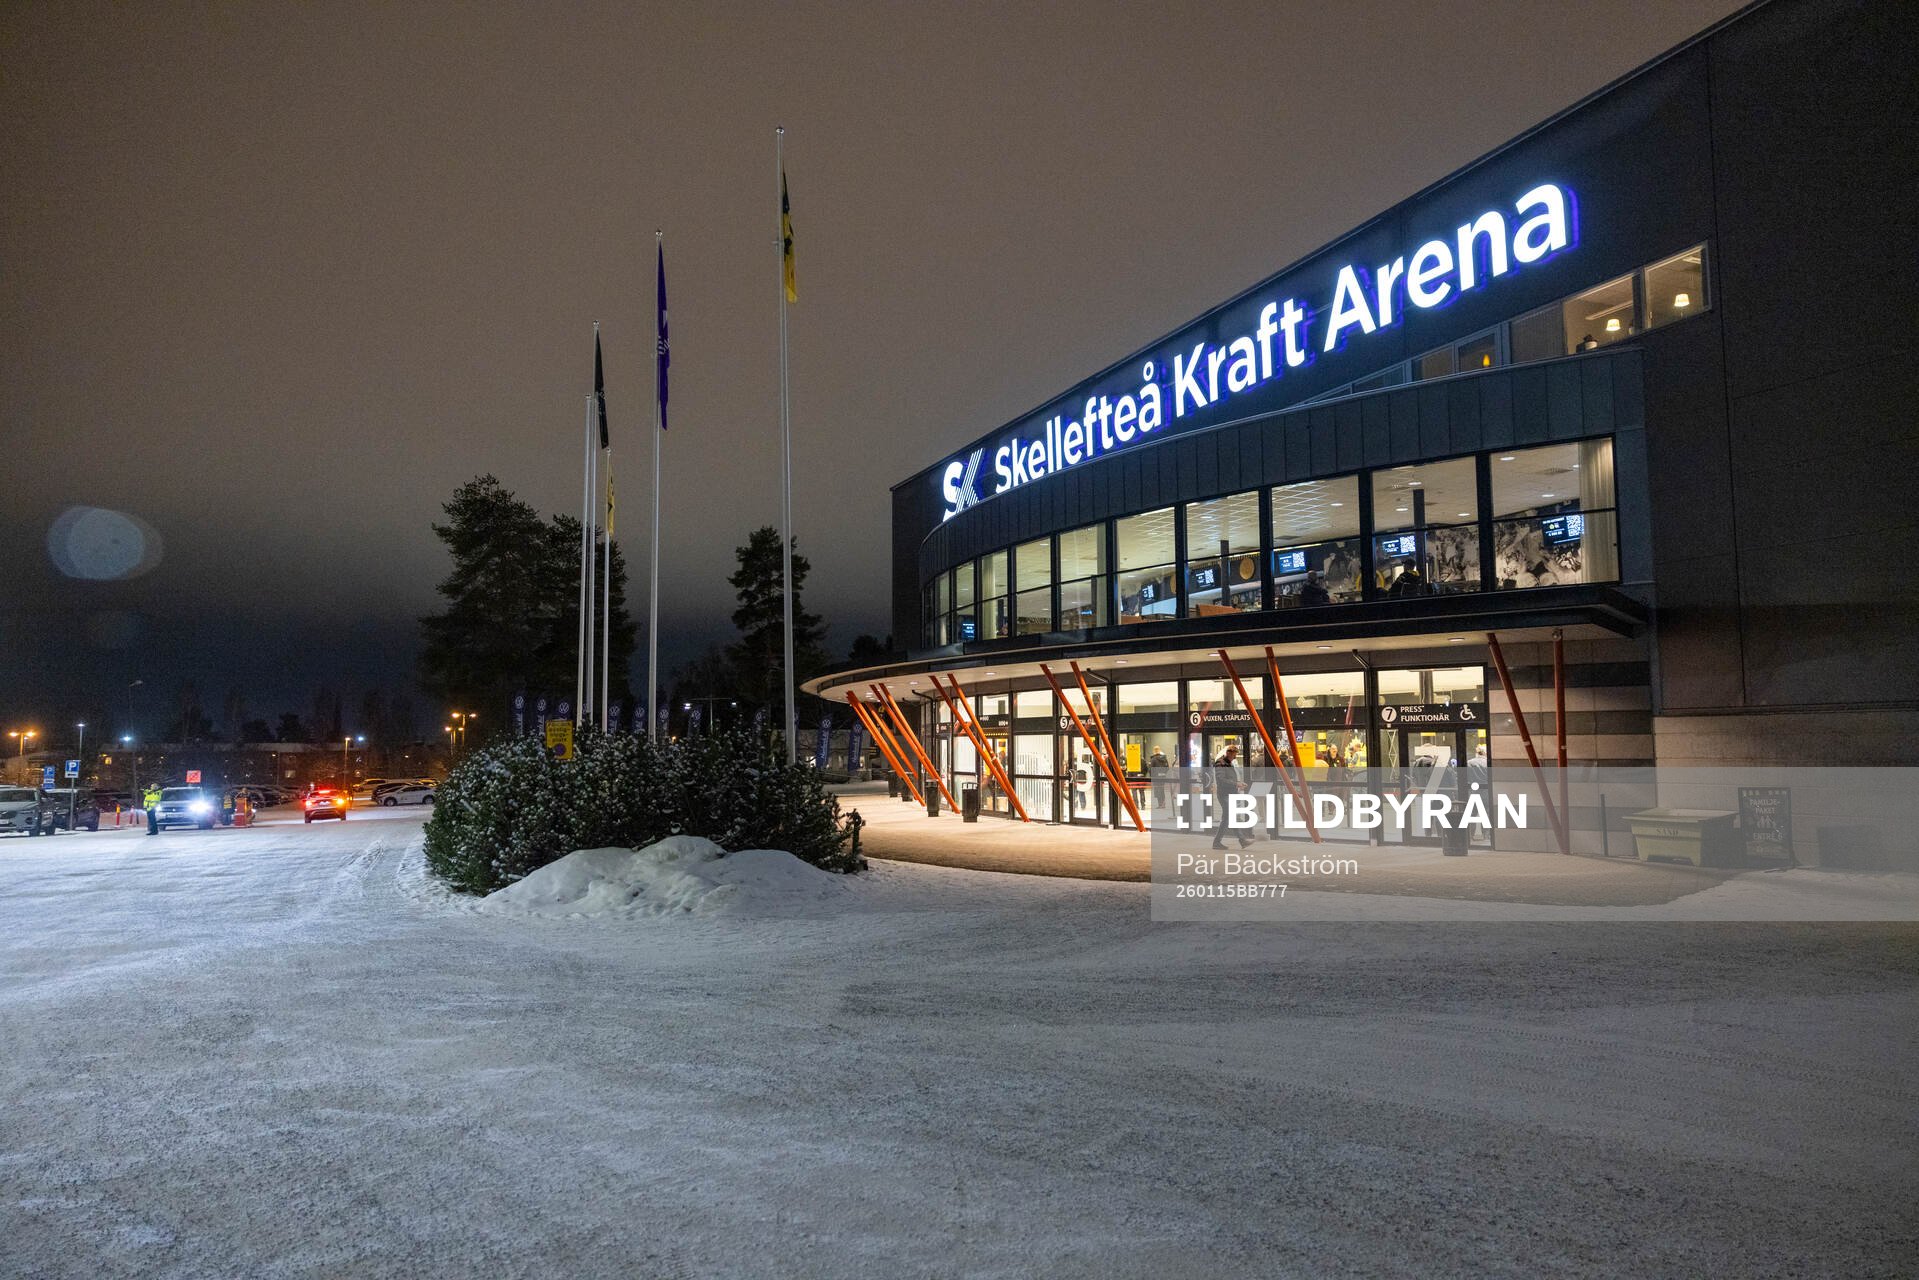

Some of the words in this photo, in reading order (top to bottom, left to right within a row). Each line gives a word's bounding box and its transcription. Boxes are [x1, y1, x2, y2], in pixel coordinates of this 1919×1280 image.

[995, 360, 1164, 494] Skellefteå
[1173, 298, 1305, 418] Kraft
[1323, 183, 1569, 352] Arena
[1400, 714, 1449, 722] FUNKTIONÄR
[1076, 747, 1094, 792] 5
[1414, 746, 1451, 797] 7
